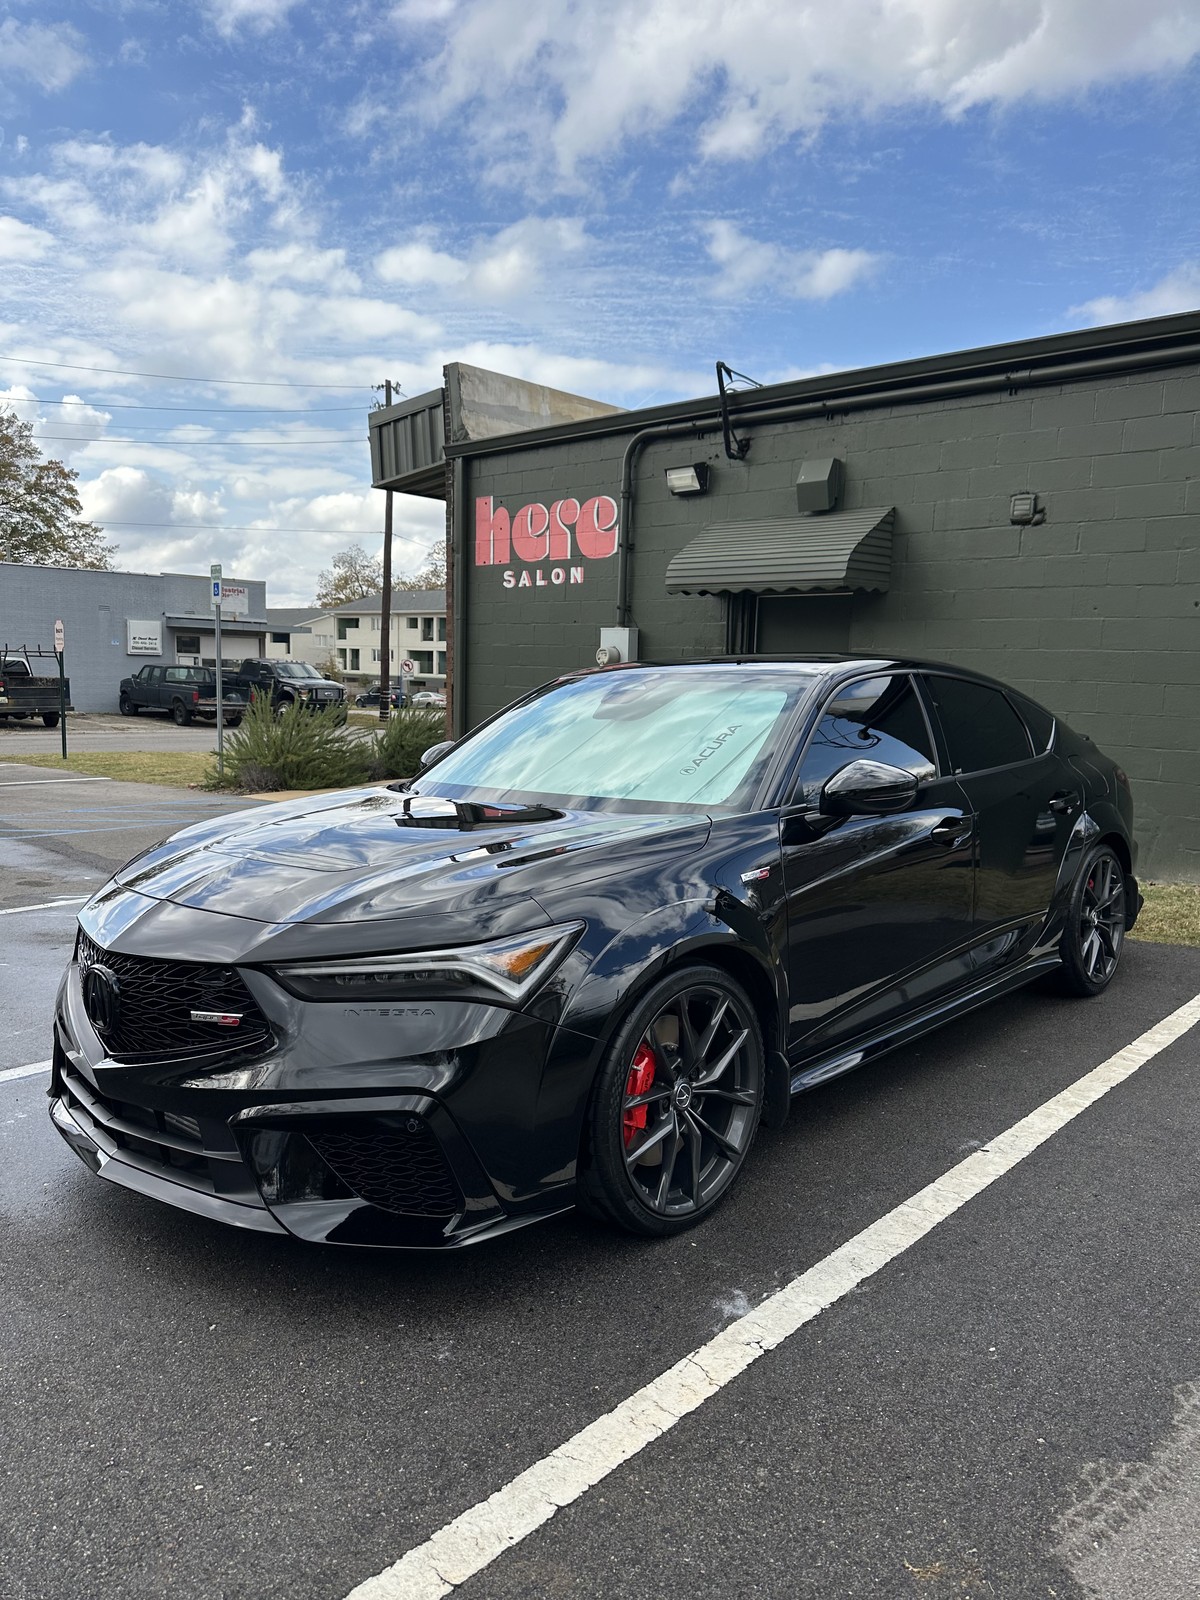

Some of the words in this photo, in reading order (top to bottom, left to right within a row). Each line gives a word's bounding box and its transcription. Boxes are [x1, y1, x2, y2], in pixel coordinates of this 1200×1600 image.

[475, 496, 619, 566] here
[503, 567, 584, 588] SALON
[692, 724, 743, 768] ACURA
[344, 1008, 436, 1017] INTEGRA
